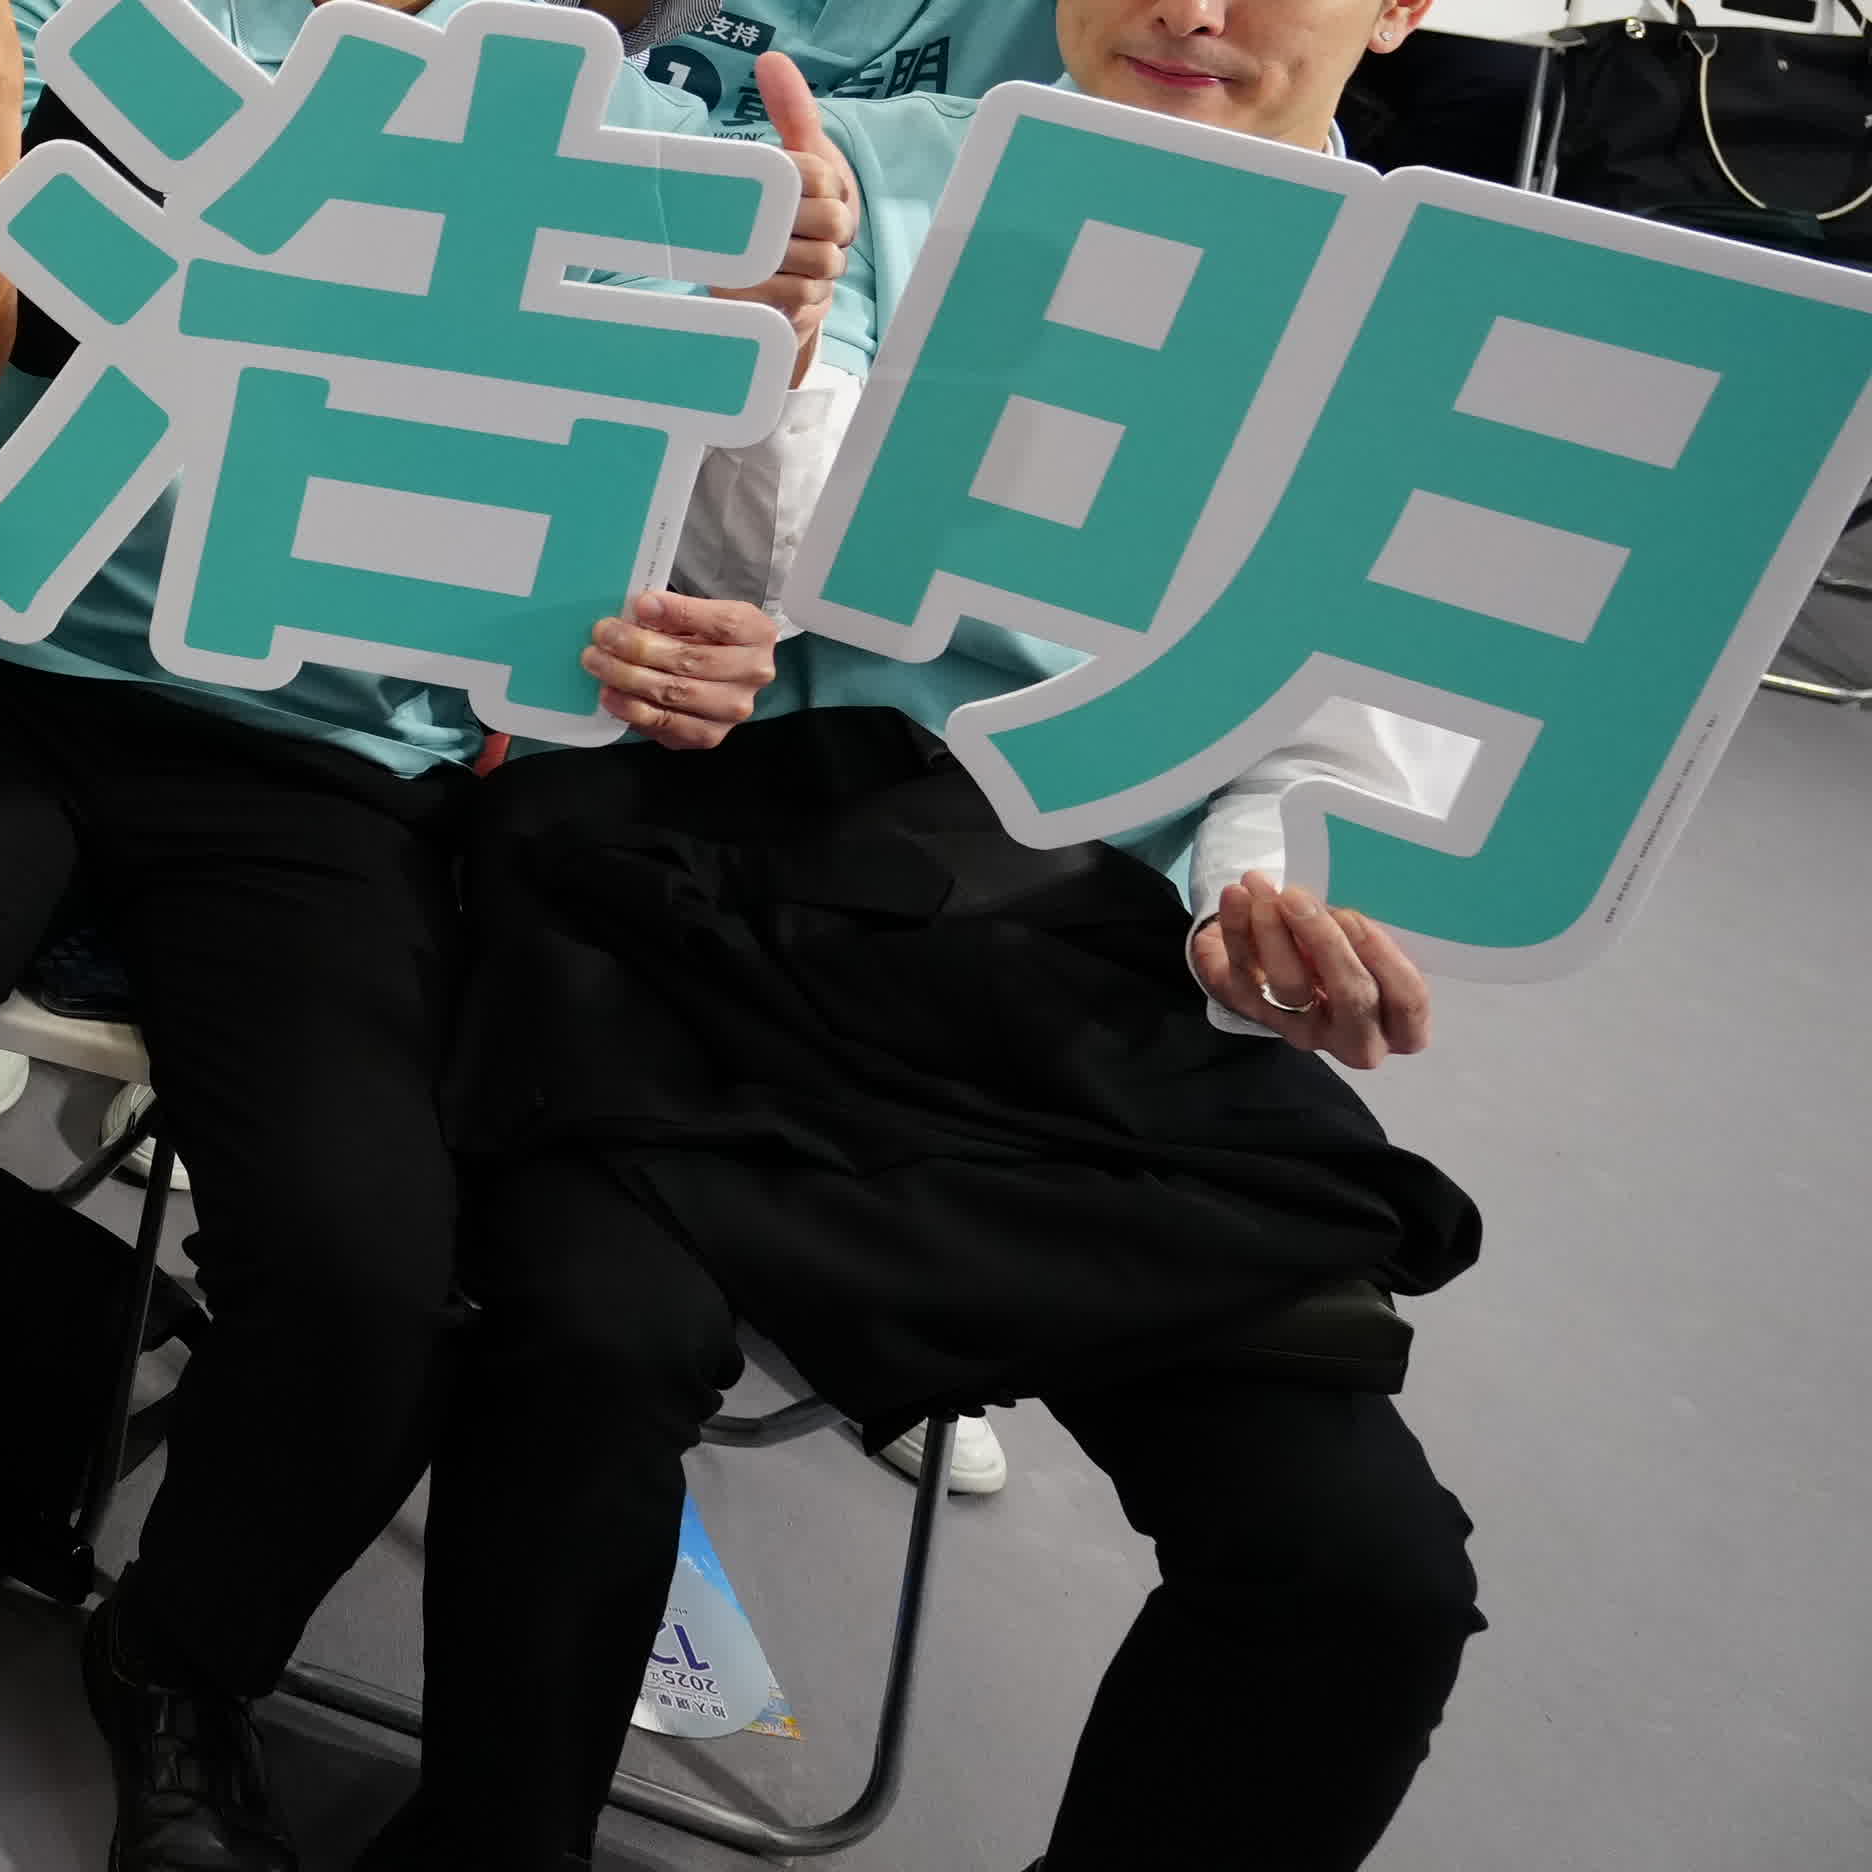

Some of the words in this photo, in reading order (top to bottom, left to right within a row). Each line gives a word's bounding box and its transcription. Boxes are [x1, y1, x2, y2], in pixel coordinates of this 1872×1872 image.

[694, 15, 761, 48] 支持
[667, 61, 692, 91] 1
[661, 1669, 720, 1695] 2025
